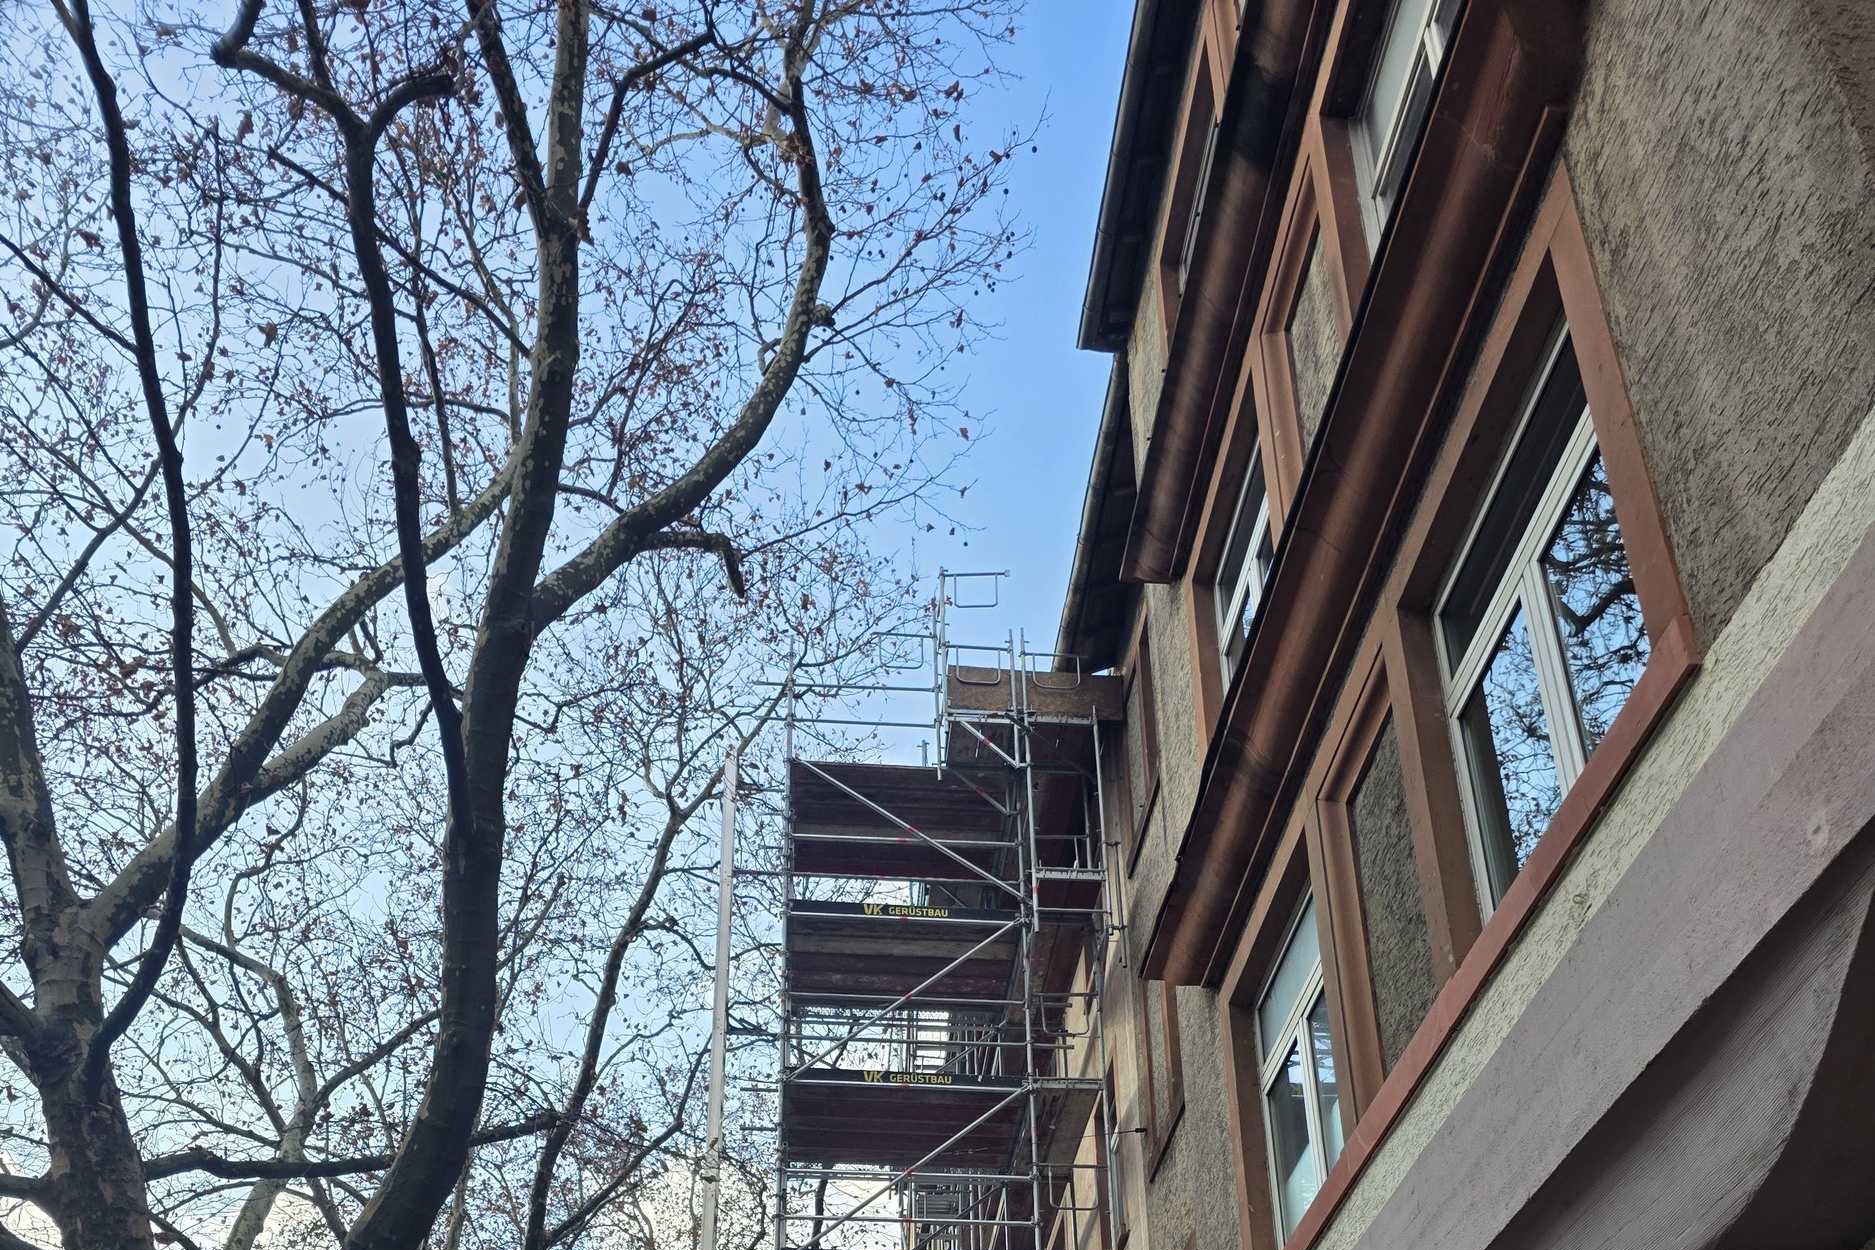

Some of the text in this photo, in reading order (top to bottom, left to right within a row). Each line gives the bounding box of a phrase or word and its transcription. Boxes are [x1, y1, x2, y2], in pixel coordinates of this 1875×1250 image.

[863, 903, 949, 918] VK GERÜSTBAU
[863, 1070, 952, 1085] VK GERÜSTBAU
